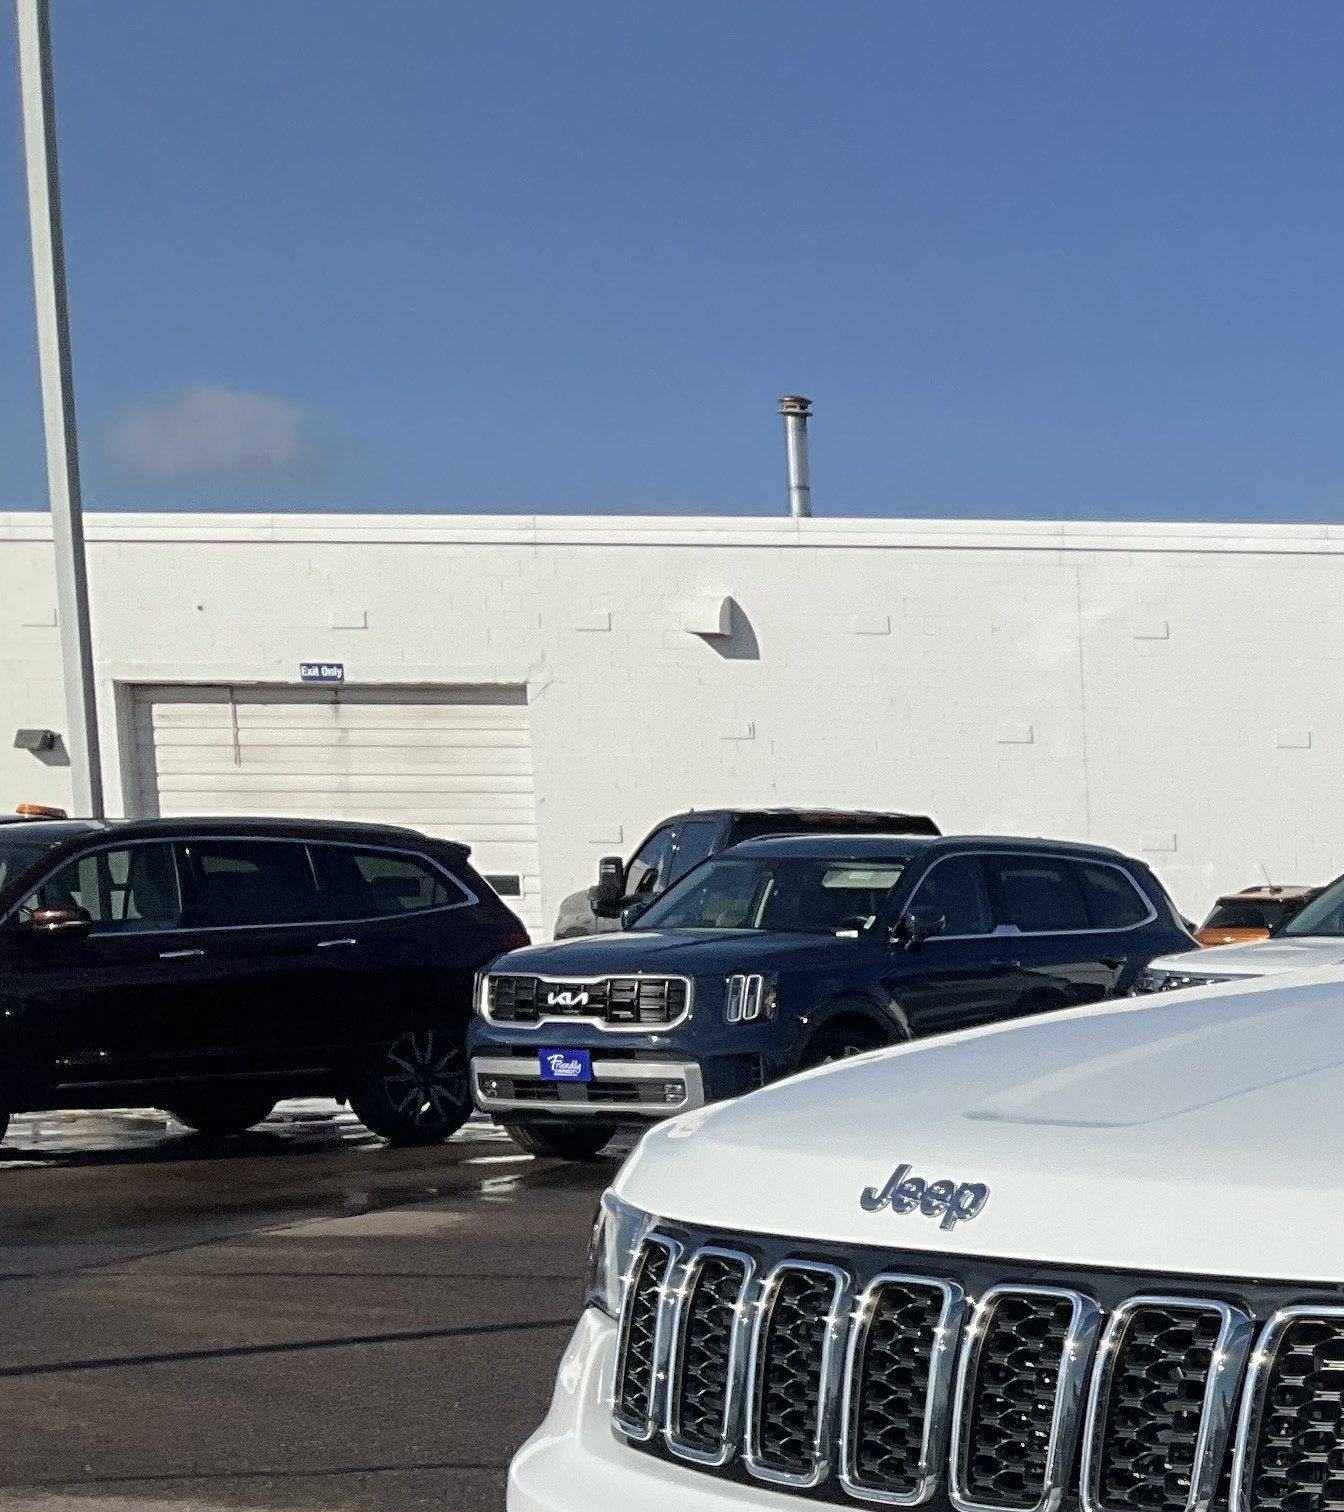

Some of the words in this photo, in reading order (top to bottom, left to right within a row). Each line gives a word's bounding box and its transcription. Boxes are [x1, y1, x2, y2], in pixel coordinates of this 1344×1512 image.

[301, 666, 319, 676] Exit
[321, 665, 342, 678] Only
[860, 1163, 990, 1231] Jeep
